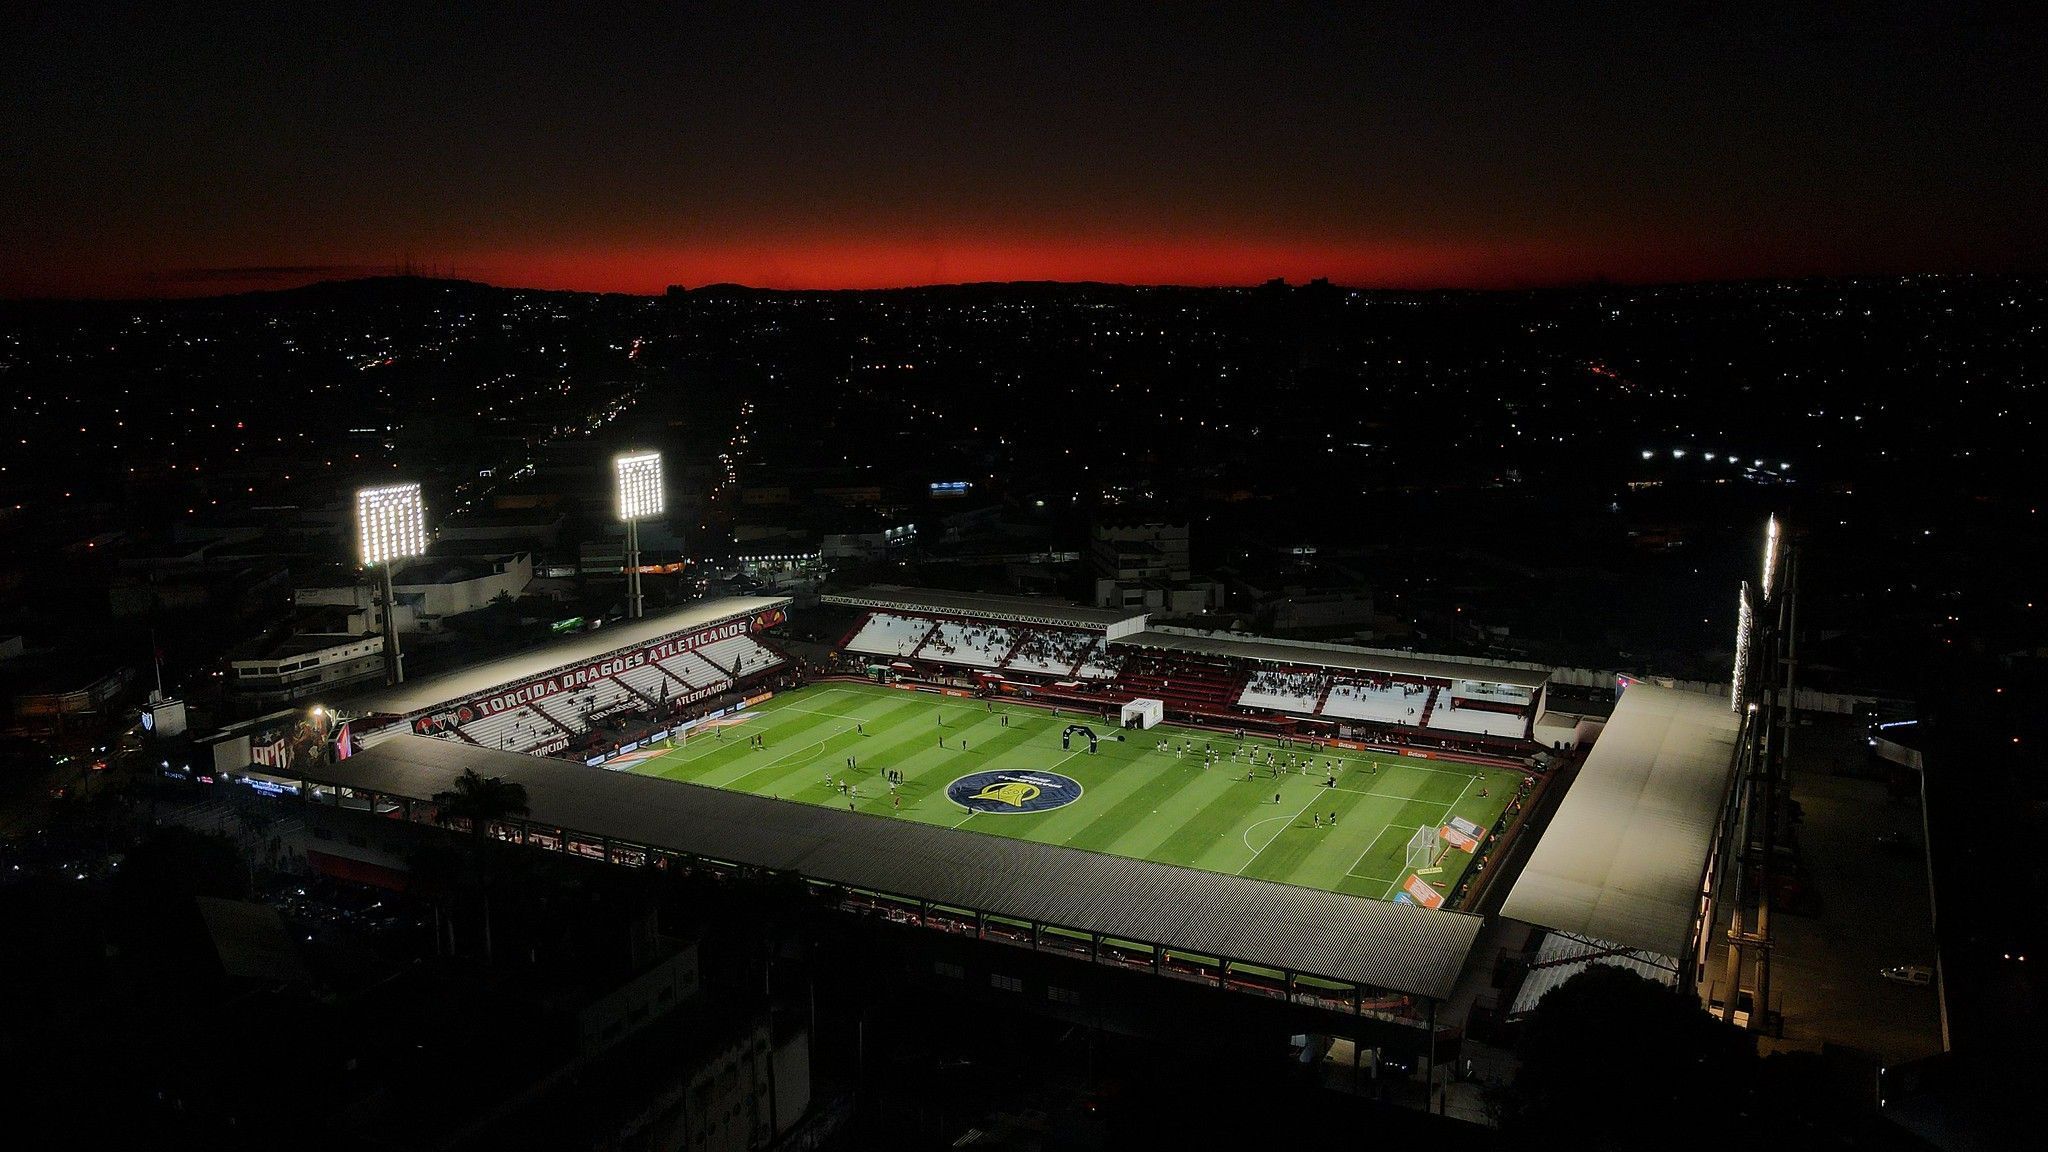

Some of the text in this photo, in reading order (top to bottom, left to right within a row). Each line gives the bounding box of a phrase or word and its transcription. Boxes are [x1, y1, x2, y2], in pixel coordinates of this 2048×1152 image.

[476, 621, 747, 716] TORCIDA DRAGÕES ATLETICANOS
[529, 738, 570, 758] TORCIDA
[676, 681, 727, 707] ATLETICANOS
